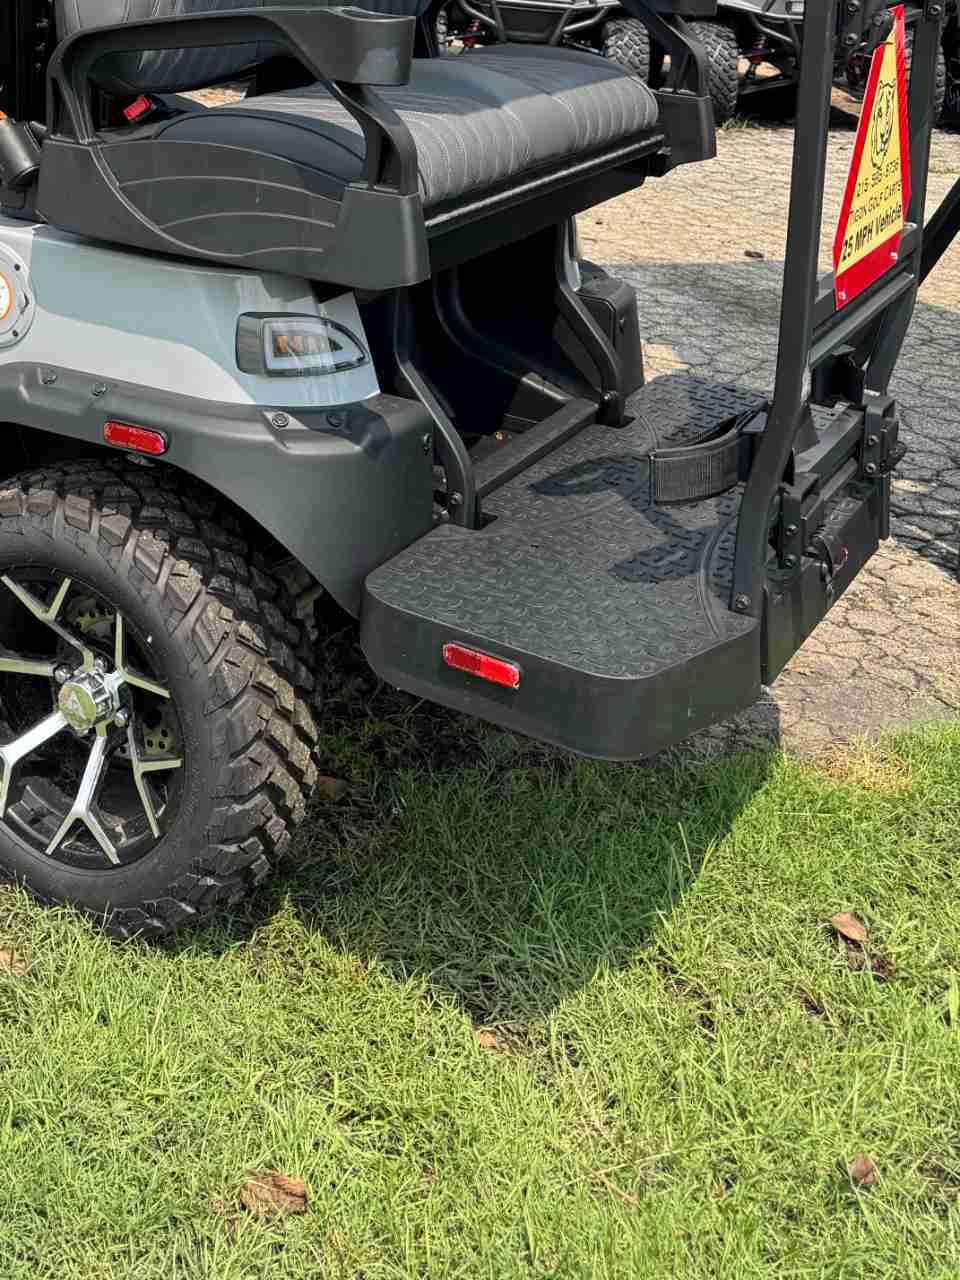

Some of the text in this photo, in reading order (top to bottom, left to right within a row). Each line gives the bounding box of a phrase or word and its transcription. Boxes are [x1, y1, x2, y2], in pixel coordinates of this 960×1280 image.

[842, 202, 901, 261] 25 MPH Vehicle
